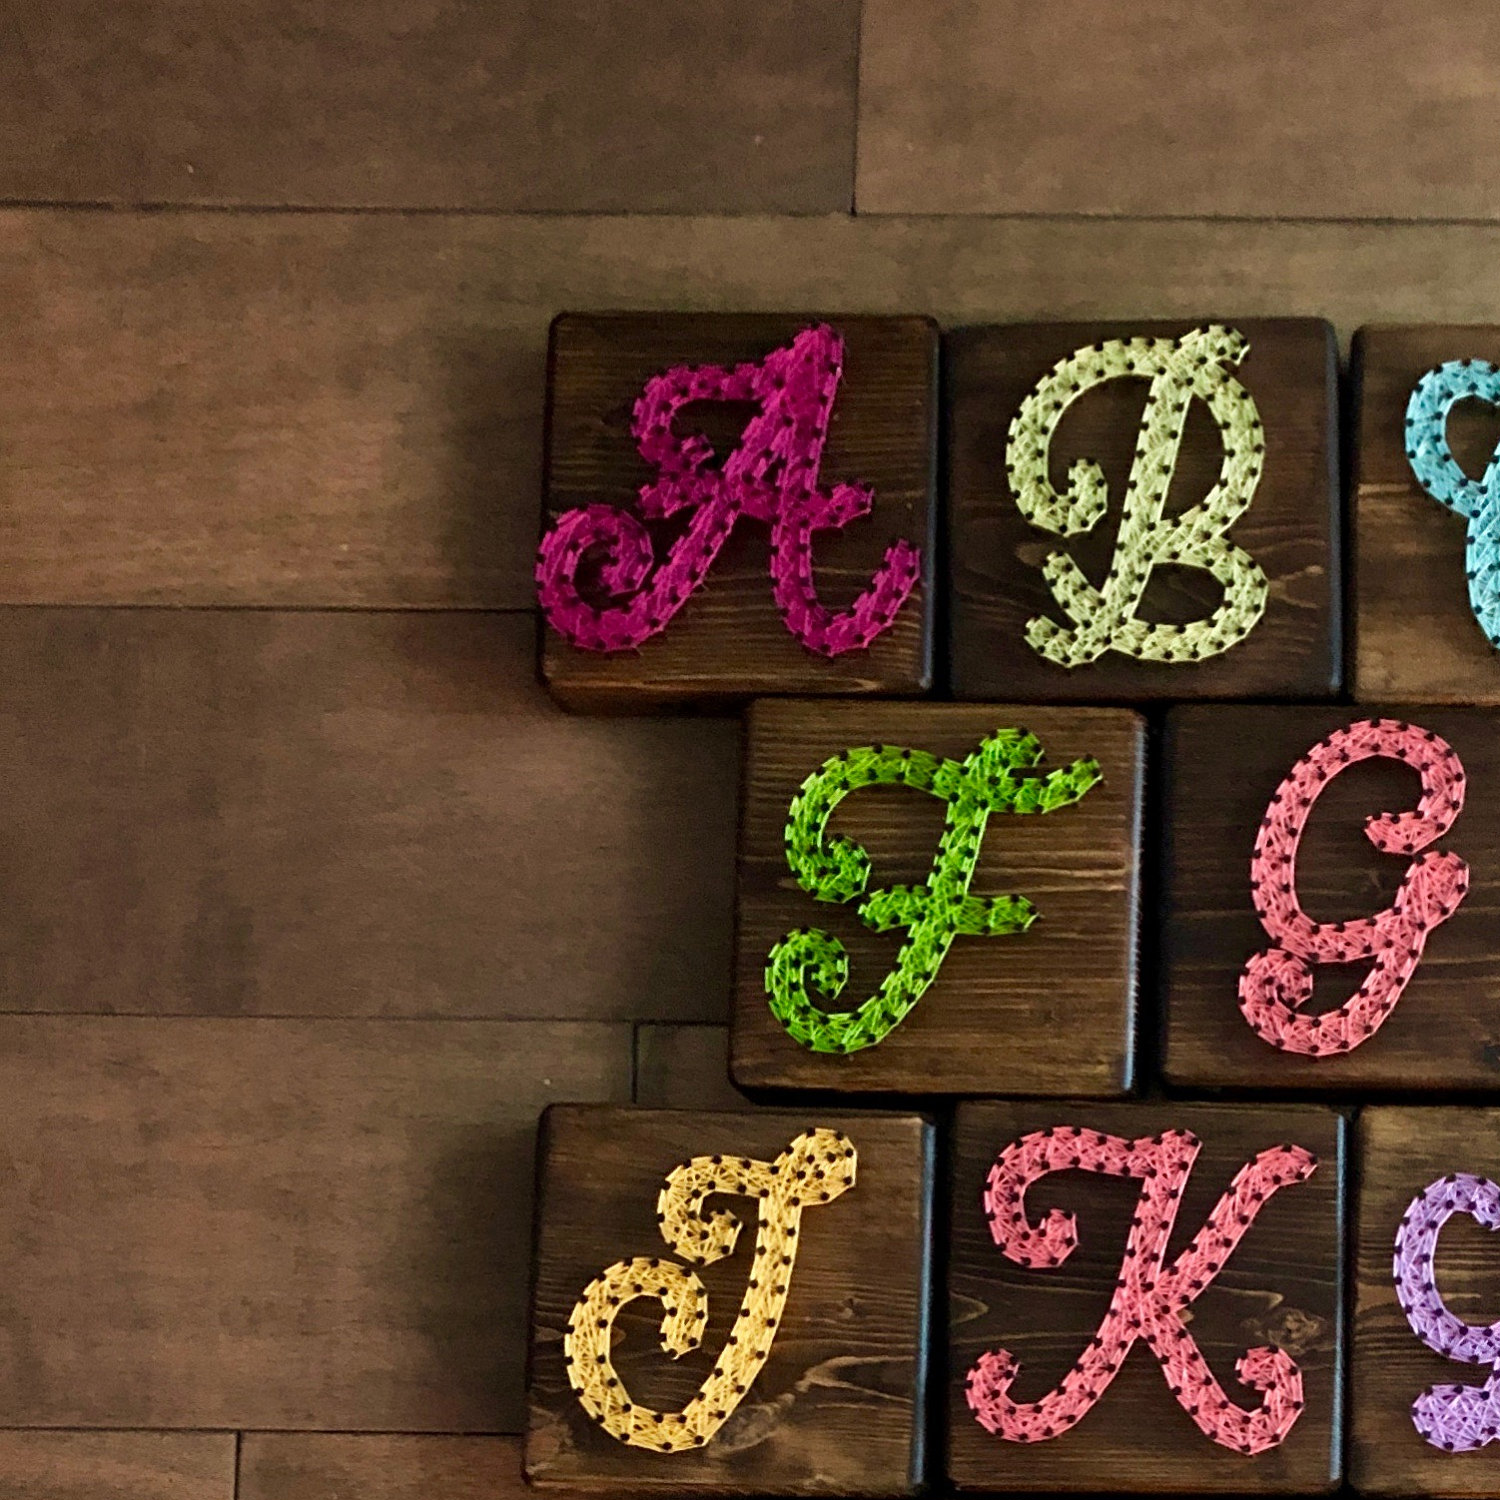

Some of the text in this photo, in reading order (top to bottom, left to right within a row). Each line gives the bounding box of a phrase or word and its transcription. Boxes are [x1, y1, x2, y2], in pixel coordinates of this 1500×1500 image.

[535, 325, 919, 656] A
[1006, 326, 1268, 667] B
[766, 729, 1096, 1051] F
[1239, 719, 1469, 1056] G
[565, 1129, 857, 1452] J
[966, 1127, 1315, 1455] K
